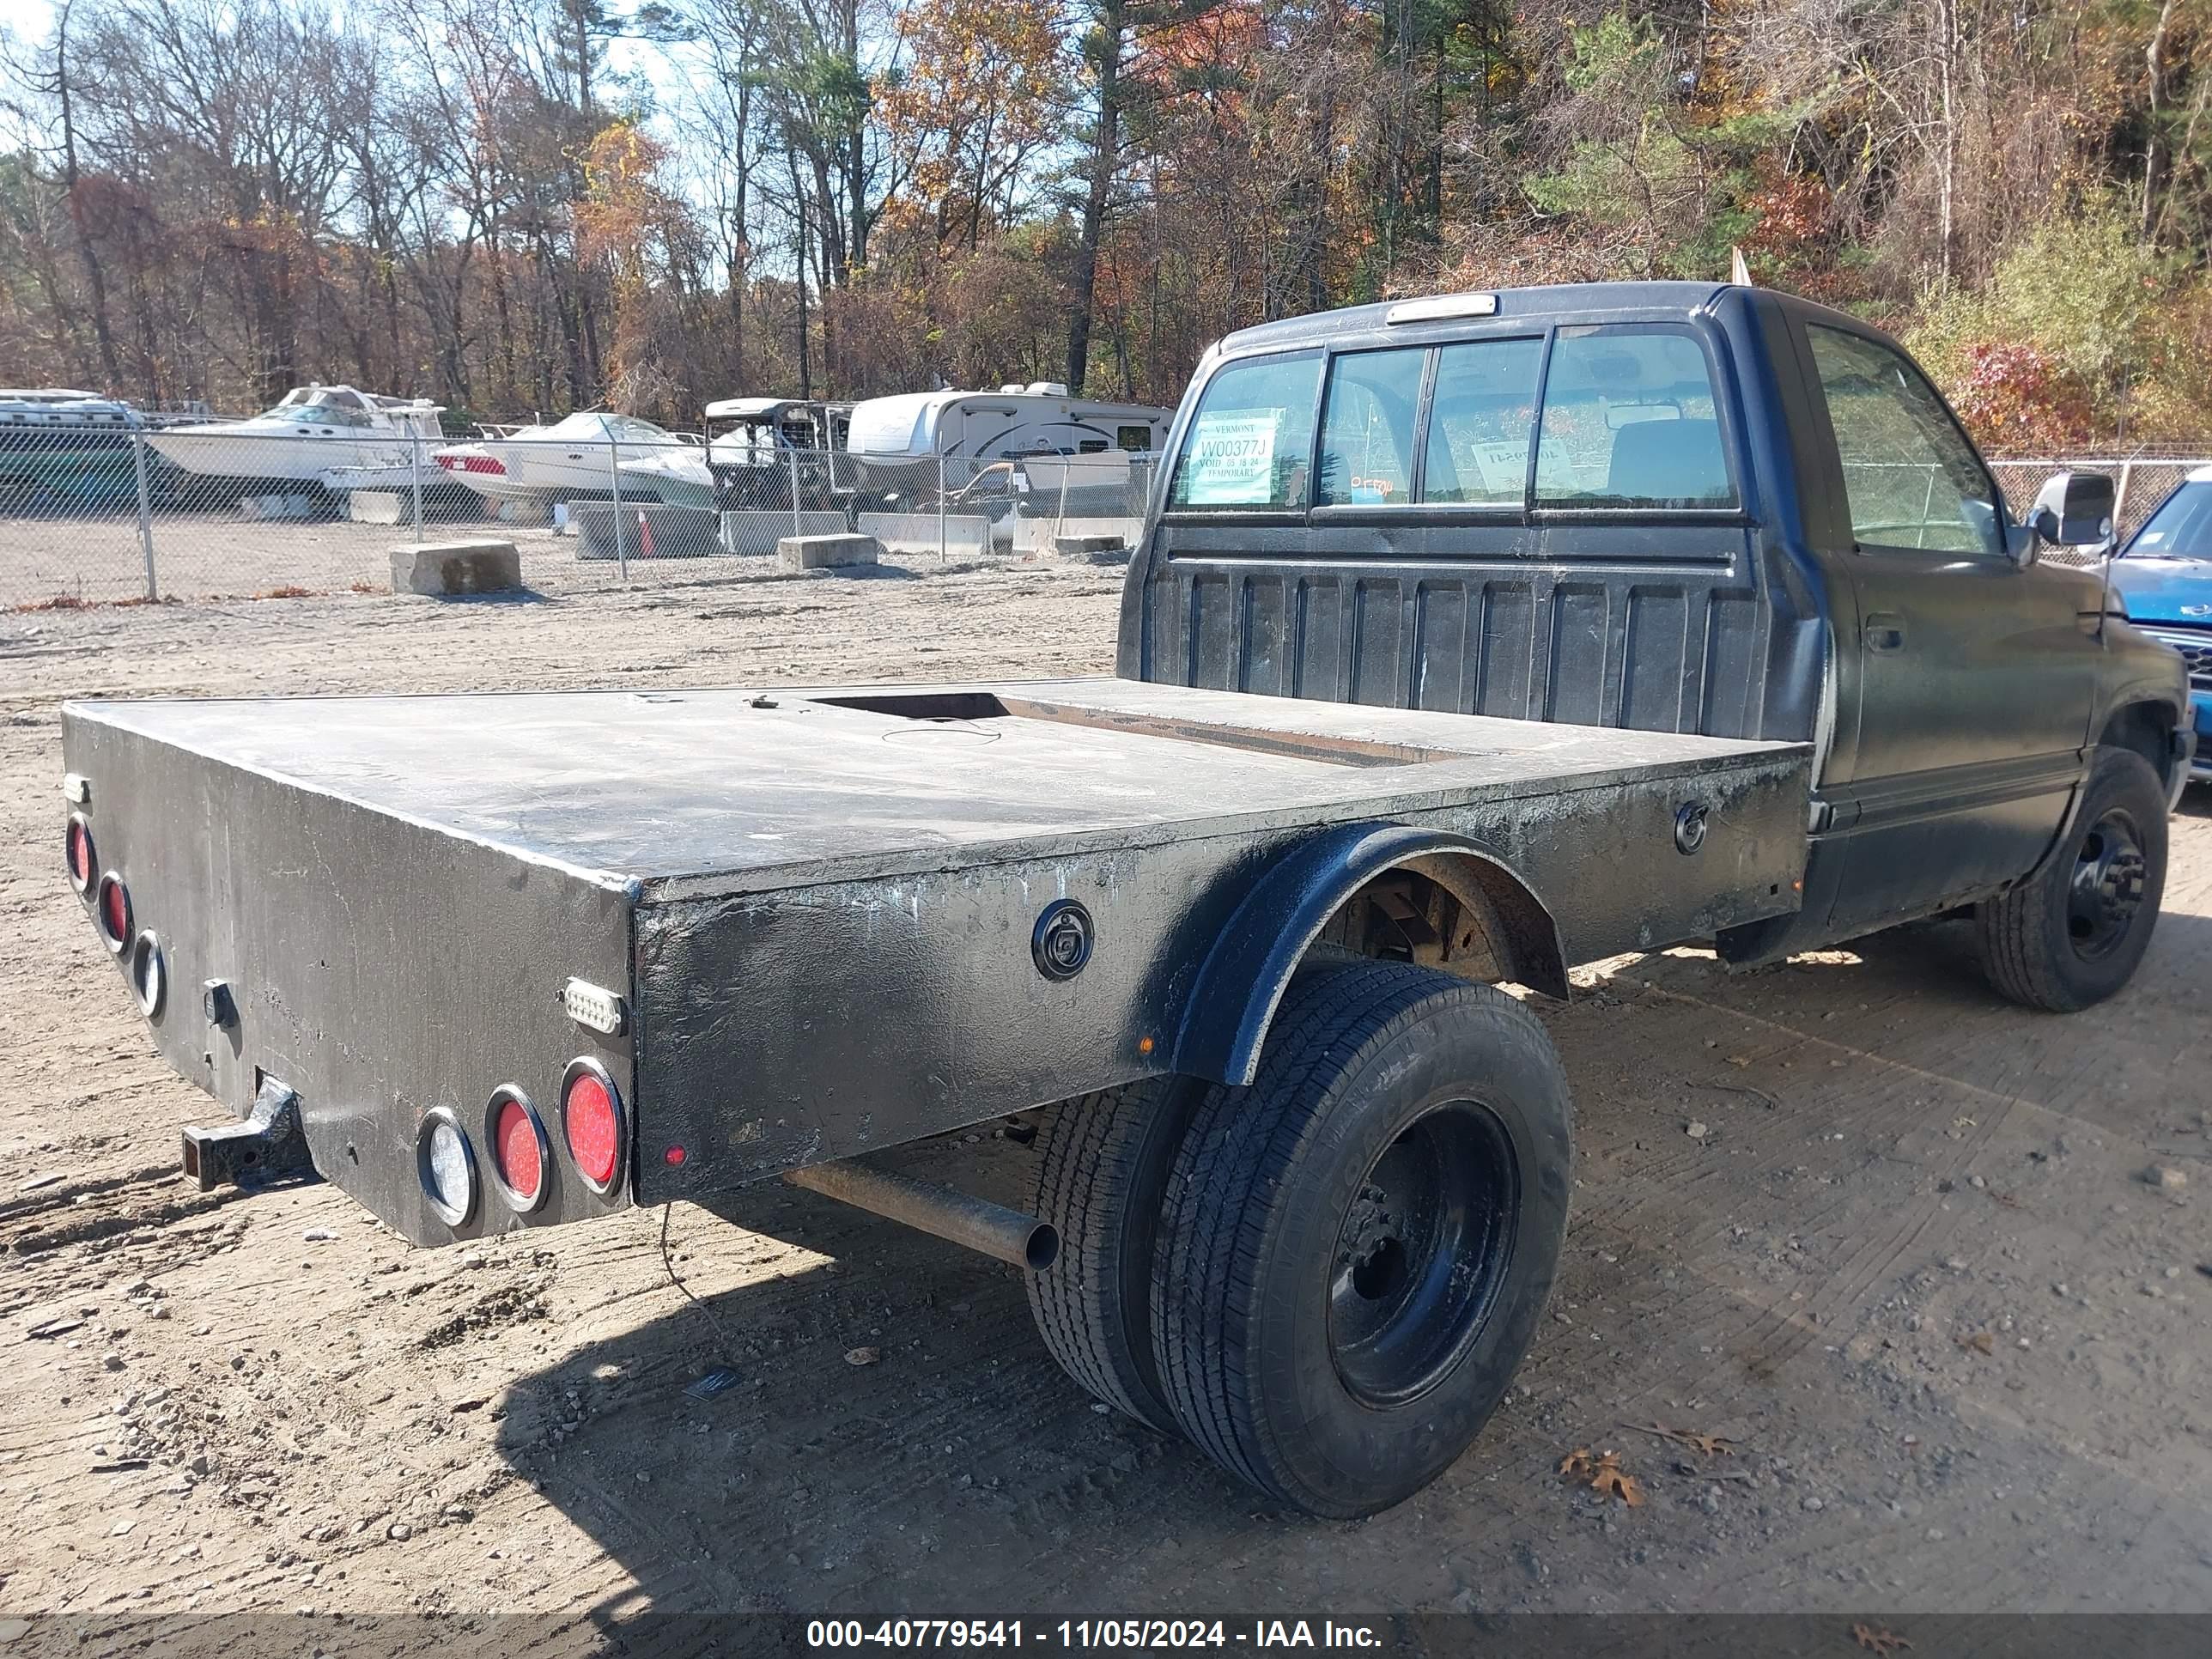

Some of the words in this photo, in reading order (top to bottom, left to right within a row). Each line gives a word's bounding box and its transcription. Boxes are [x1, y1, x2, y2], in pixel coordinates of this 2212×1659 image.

[1215, 424, 1255, 434] VERMONT
[1200, 458, 1222, 468] VOID
[1250, 458, 1259, 466] 24
[1208, 468, 1255, 477] TEMPORARY
